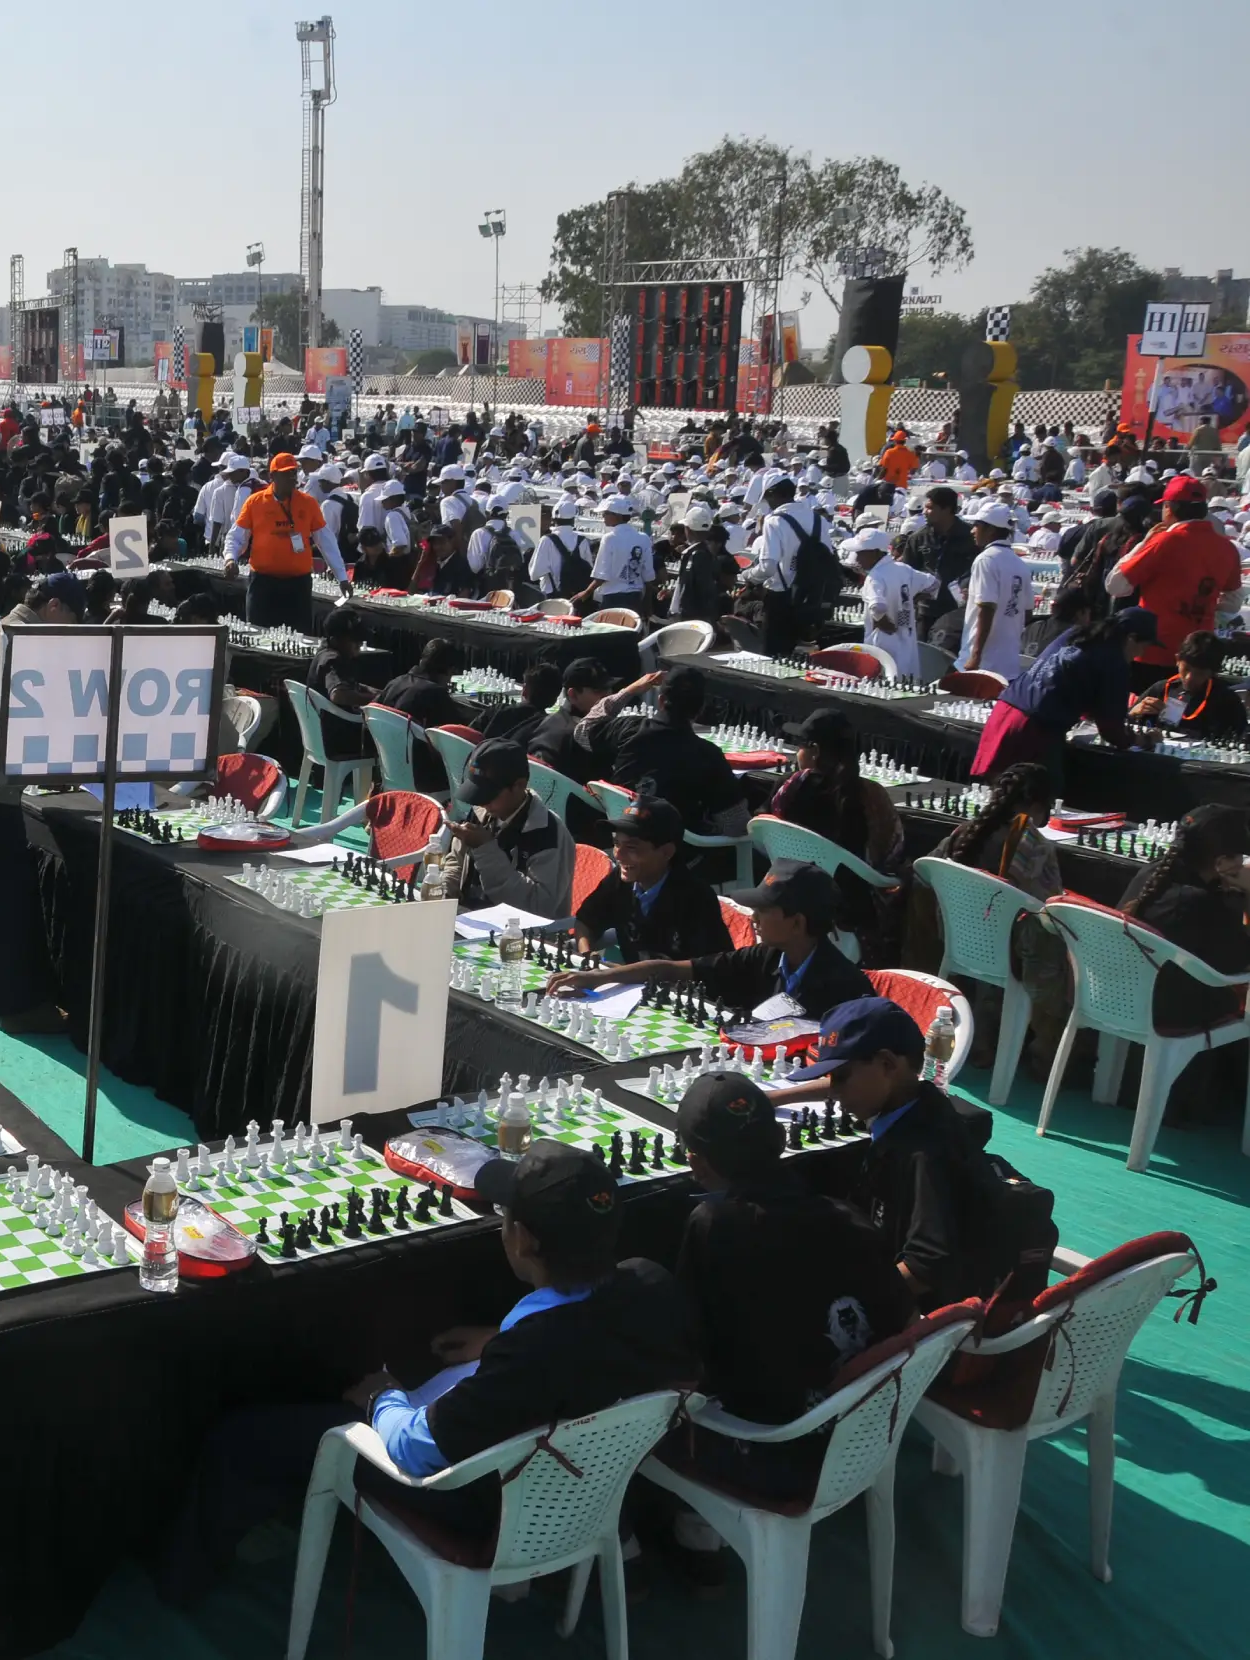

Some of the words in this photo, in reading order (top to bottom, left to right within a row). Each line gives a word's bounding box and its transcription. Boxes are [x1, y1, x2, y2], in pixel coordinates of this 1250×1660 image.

[1145, 312, 1179, 333] H1
[1182, 312, 1206, 333] H1
[95, 339, 110, 350] H2
